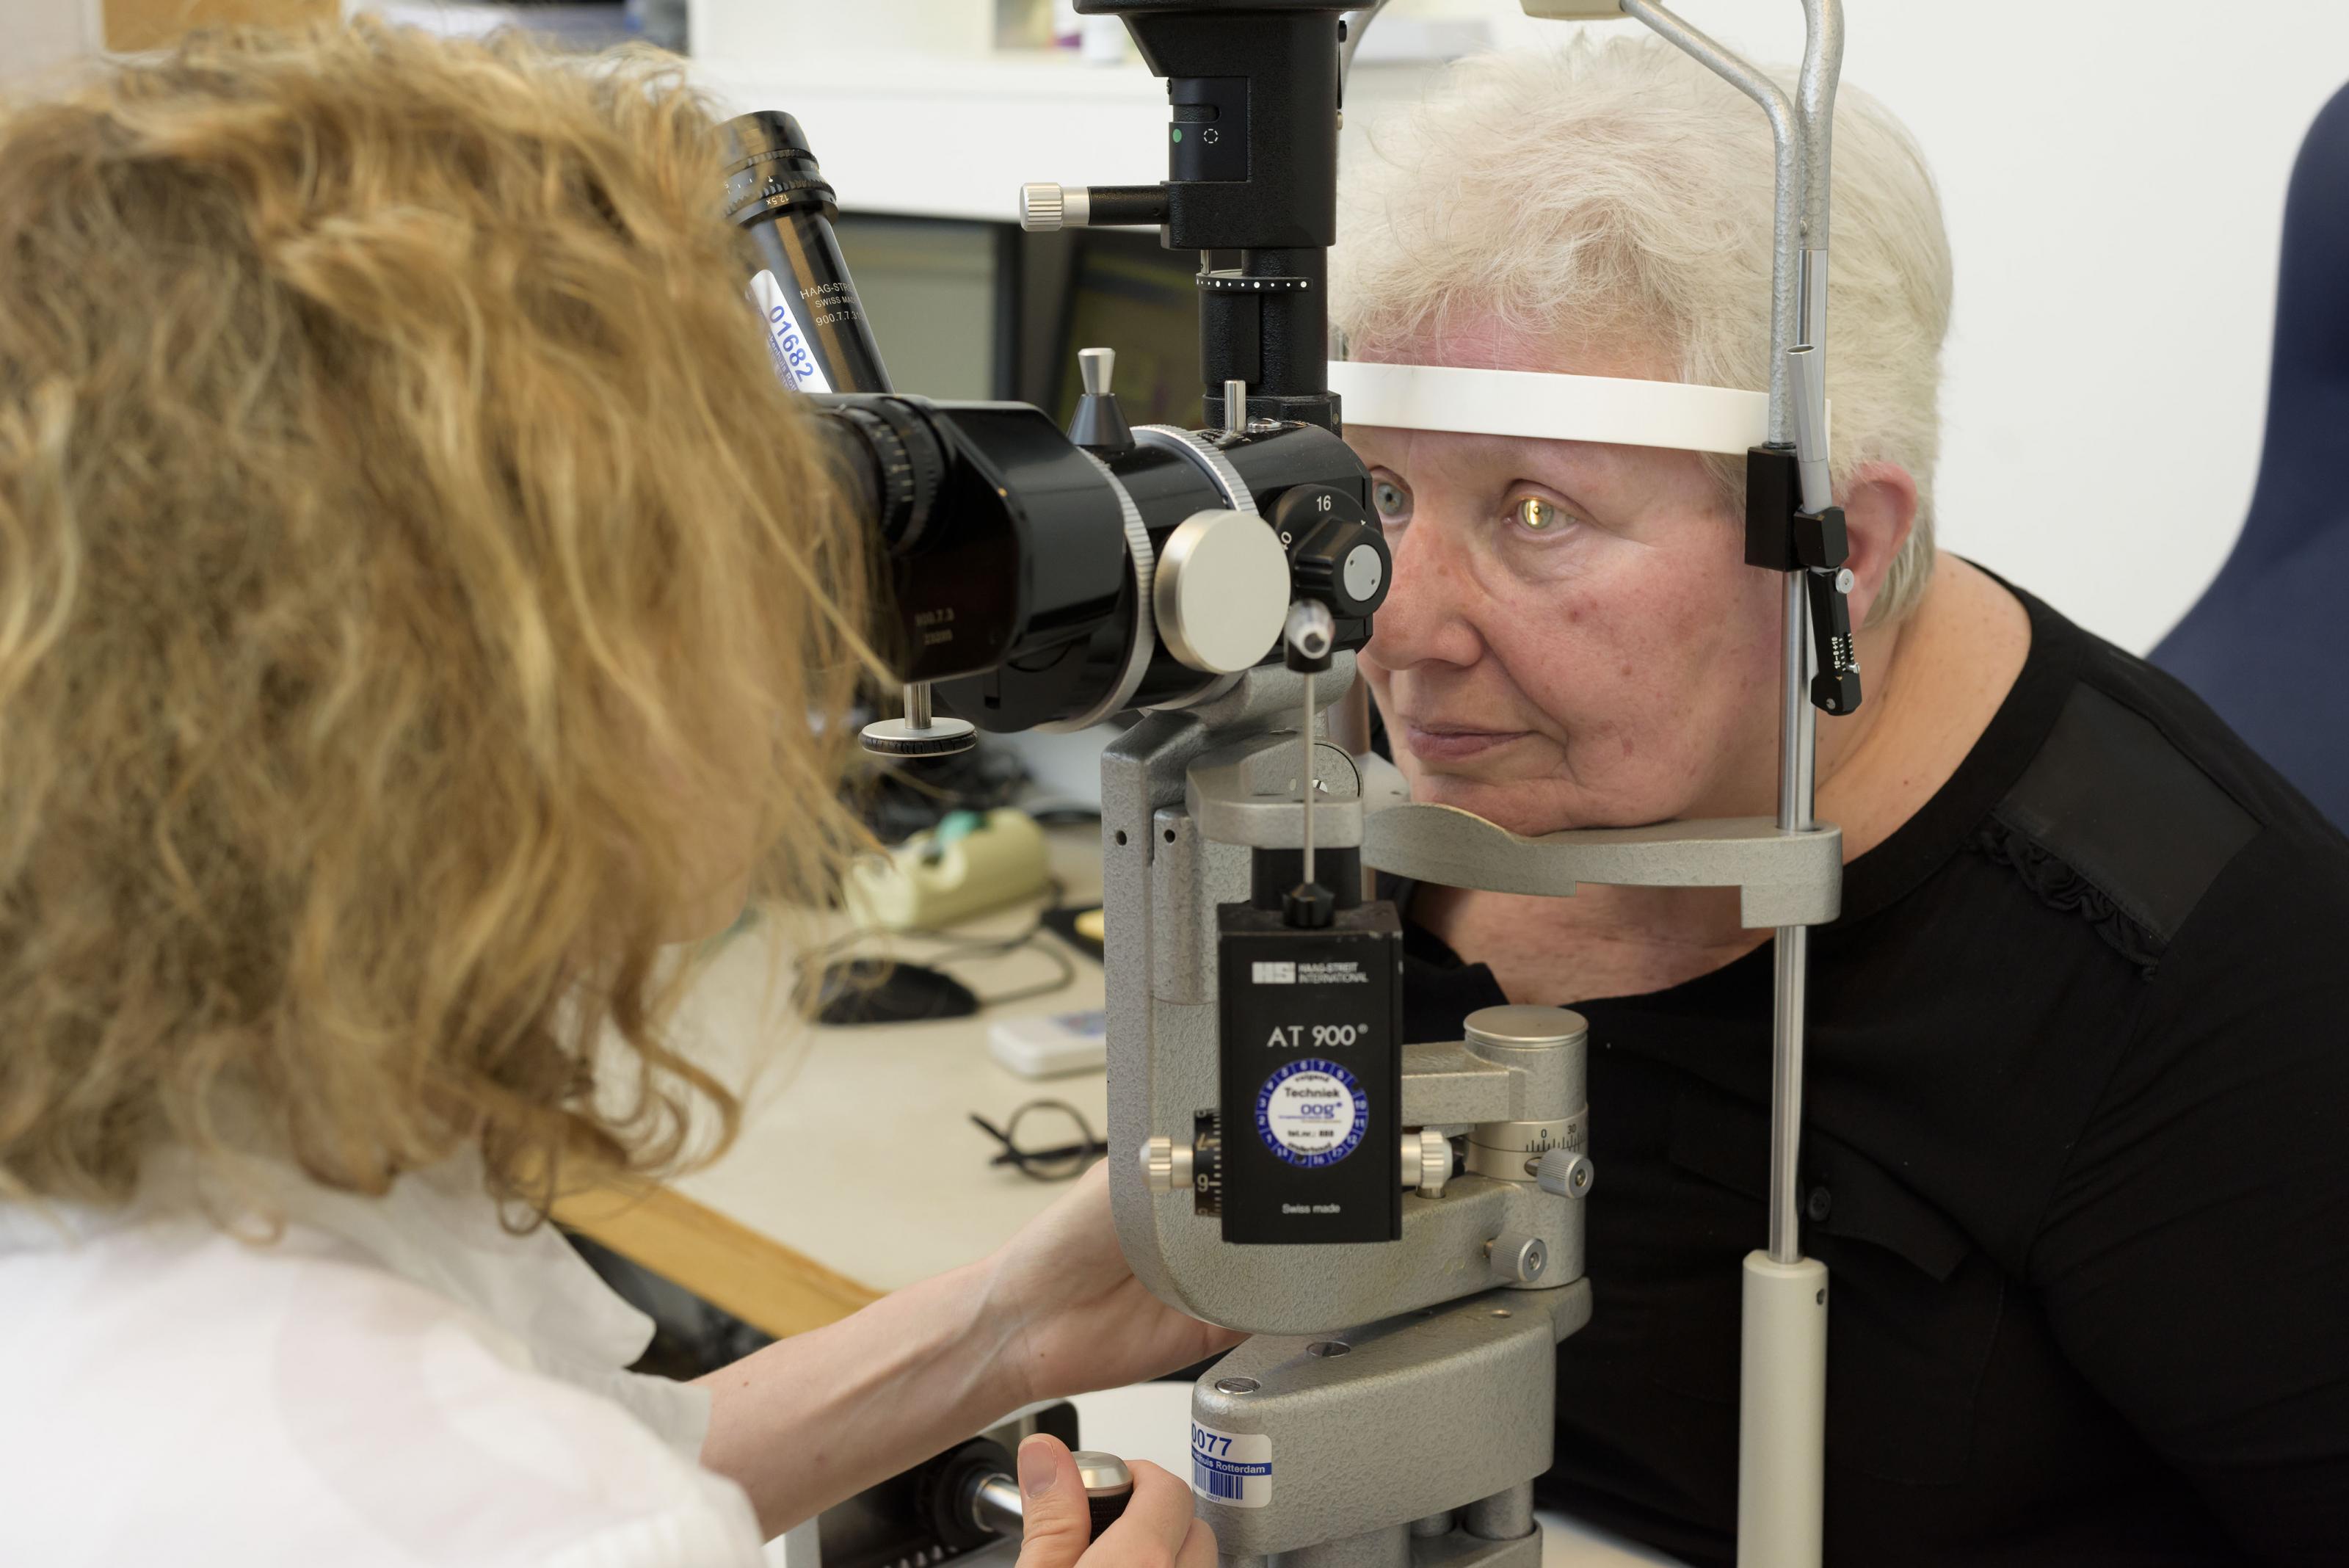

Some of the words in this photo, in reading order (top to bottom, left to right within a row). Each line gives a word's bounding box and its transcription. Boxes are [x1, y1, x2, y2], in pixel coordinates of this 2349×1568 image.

[815, 297, 841, 308] SWISS
[769, 305, 813, 382] 01682
[1316, 495, 1332, 512] 16
[1298, 973, 1369, 984] INTERNATIONAL
[1266, 1026, 1304, 1048] AT
[1285, 1087, 1340, 1098] Techniek
[1301, 1103, 1335, 1119] oog
[1541, 1128, 1547, 1139] 0
[1197, 1174, 1209, 1192] 9
[1282, 1204, 1310, 1213] Swiss
[1313, 1204, 1340, 1213] made
[1216, 1461, 1266, 1473] Rotterdam
